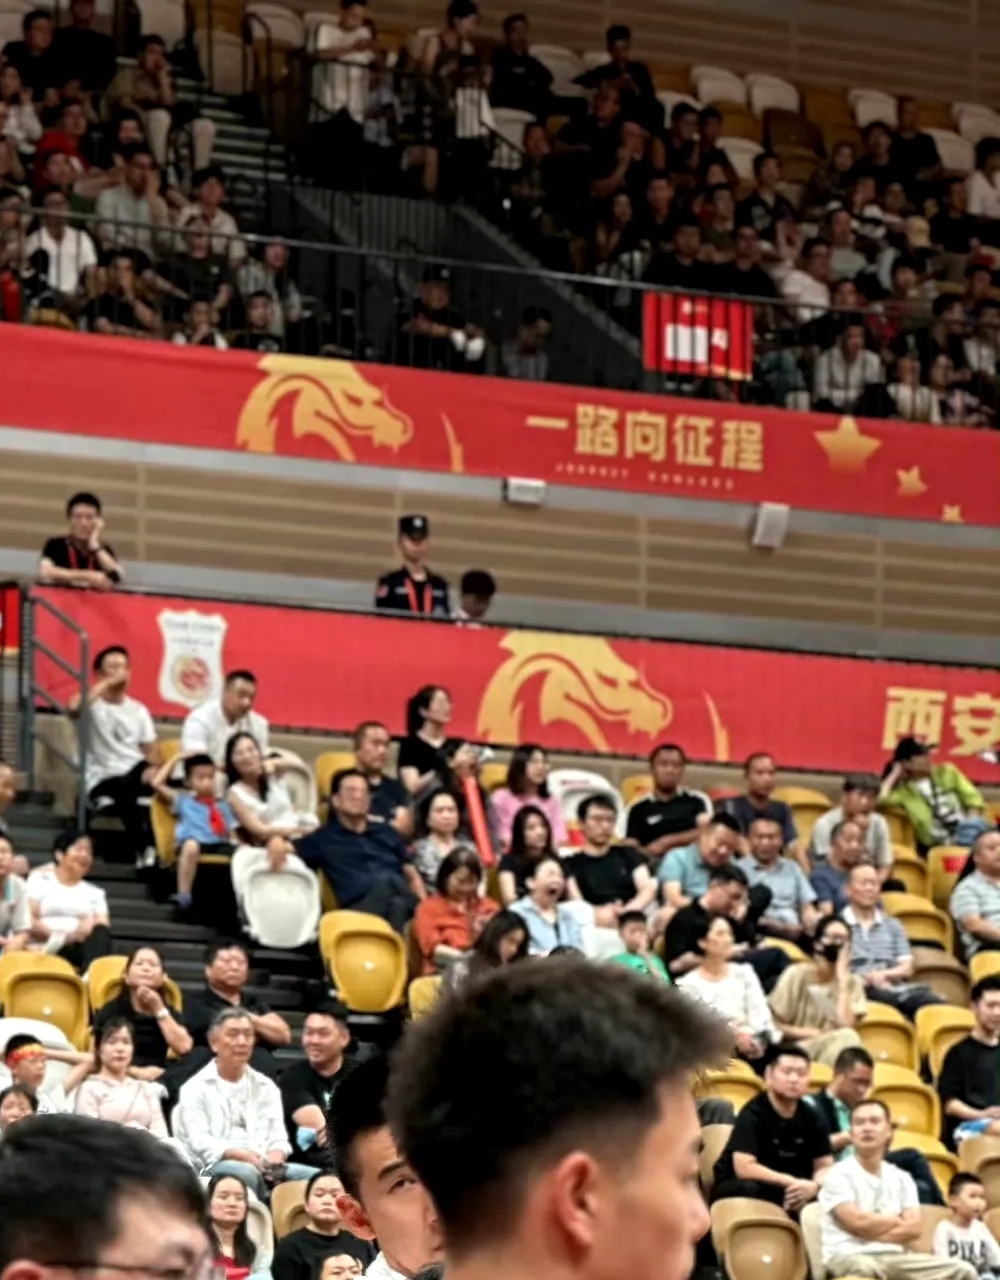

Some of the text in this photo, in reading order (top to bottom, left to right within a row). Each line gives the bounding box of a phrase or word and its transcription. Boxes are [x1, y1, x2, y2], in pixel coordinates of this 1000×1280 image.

[525, 402, 764, 472] 一路向征程
[881, 686, 1000, 756] 西安
